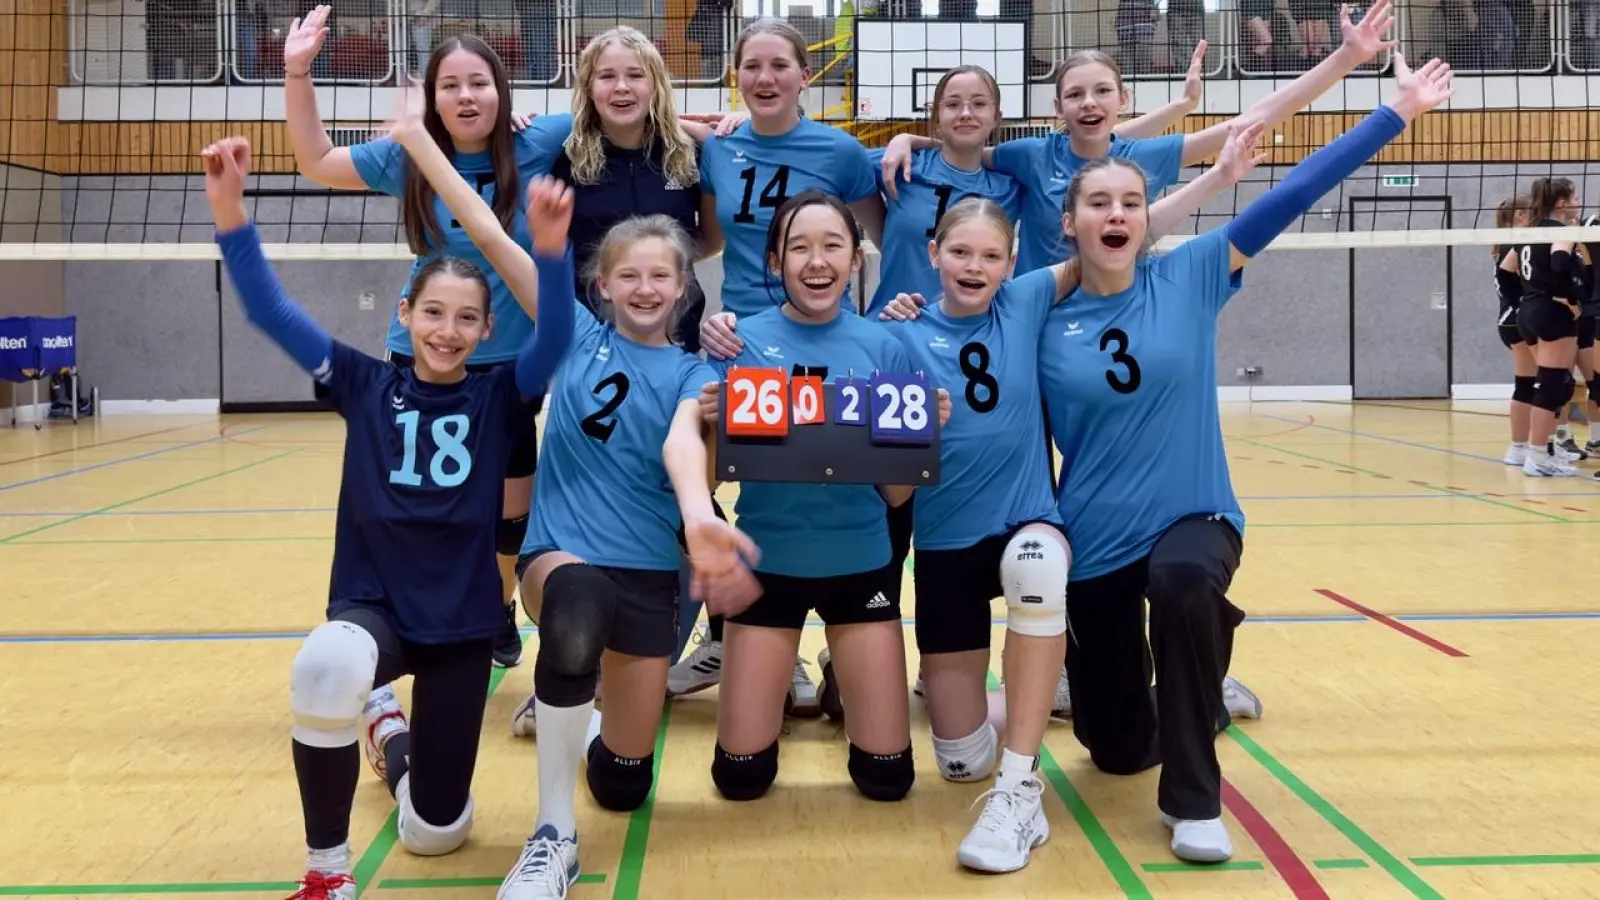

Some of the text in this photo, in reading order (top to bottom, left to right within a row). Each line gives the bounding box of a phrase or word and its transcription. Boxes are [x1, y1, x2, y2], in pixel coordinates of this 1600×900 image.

[733, 164, 790, 223] 14
[1520, 244, 1532, 281] 8
[0, 335, 28, 350] lten
[1099, 327, 1141, 395] 3
[580, 370, 631, 445] 2
[732, 378, 928, 432] 26 0 2 28
[959, 341, 999, 414] 8
[389, 409, 472, 488] 18
